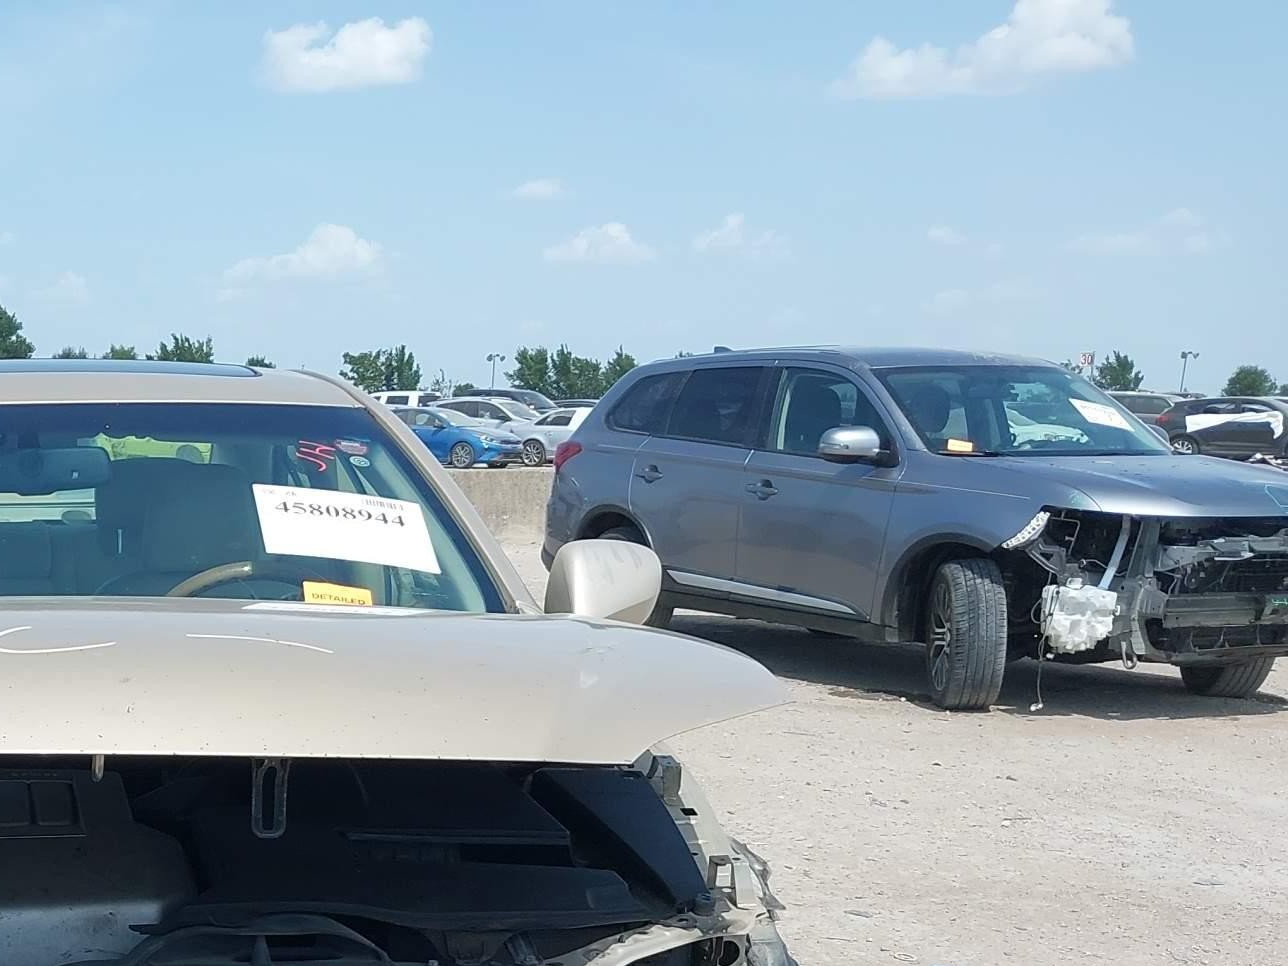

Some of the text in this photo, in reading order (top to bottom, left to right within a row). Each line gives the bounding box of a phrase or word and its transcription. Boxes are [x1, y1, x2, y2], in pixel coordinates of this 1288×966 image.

[1080, 354, 1093, 365] 30
[275, 501, 405, 527] 45808944
[312, 592, 366, 605] DETAILED
